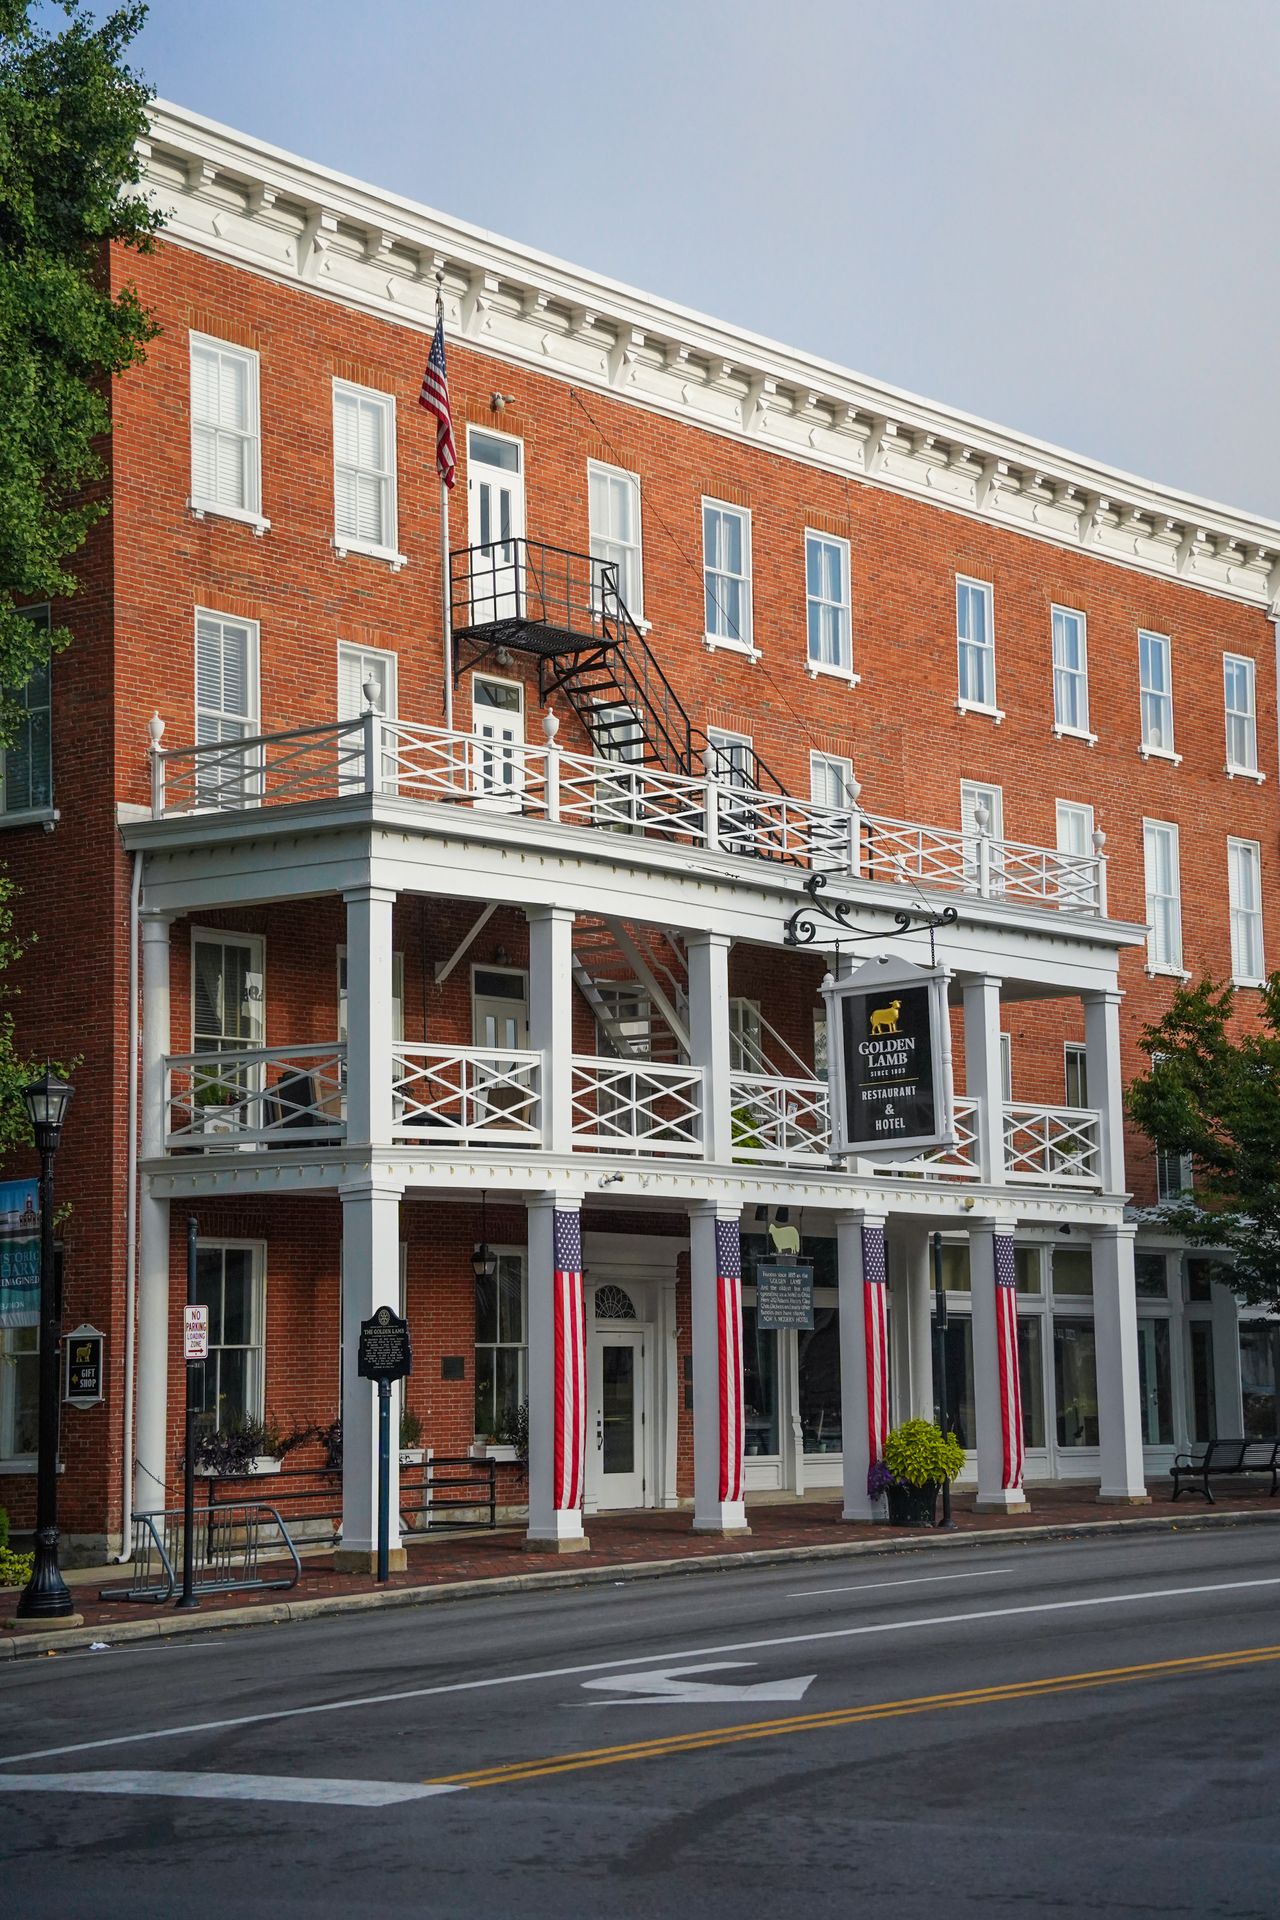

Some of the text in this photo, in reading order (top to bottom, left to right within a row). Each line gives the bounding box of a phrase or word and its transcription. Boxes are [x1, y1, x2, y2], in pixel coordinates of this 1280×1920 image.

[858, 1037, 916, 1055] GOLDEN
[867, 1053, 908, 1068] LAMB
[890, 1068, 906, 1076] 1803
[861, 1085, 917, 1101] RESTAURANT
[884, 1104, 895, 1115] &
[875, 1117, 906, 1131] HOTEL
[0, 1250, 39, 1264] STORIC
[0, 1276, 40, 1287] IMAGINED
[191, 1310, 201, 1321] NO
[186, 1322, 206, 1332] PARKING
[190, 1340, 201, 1348] ZONE
[81, 1368, 96, 1378] GIFT
[79, 1379, 97, 1388] SHOP
